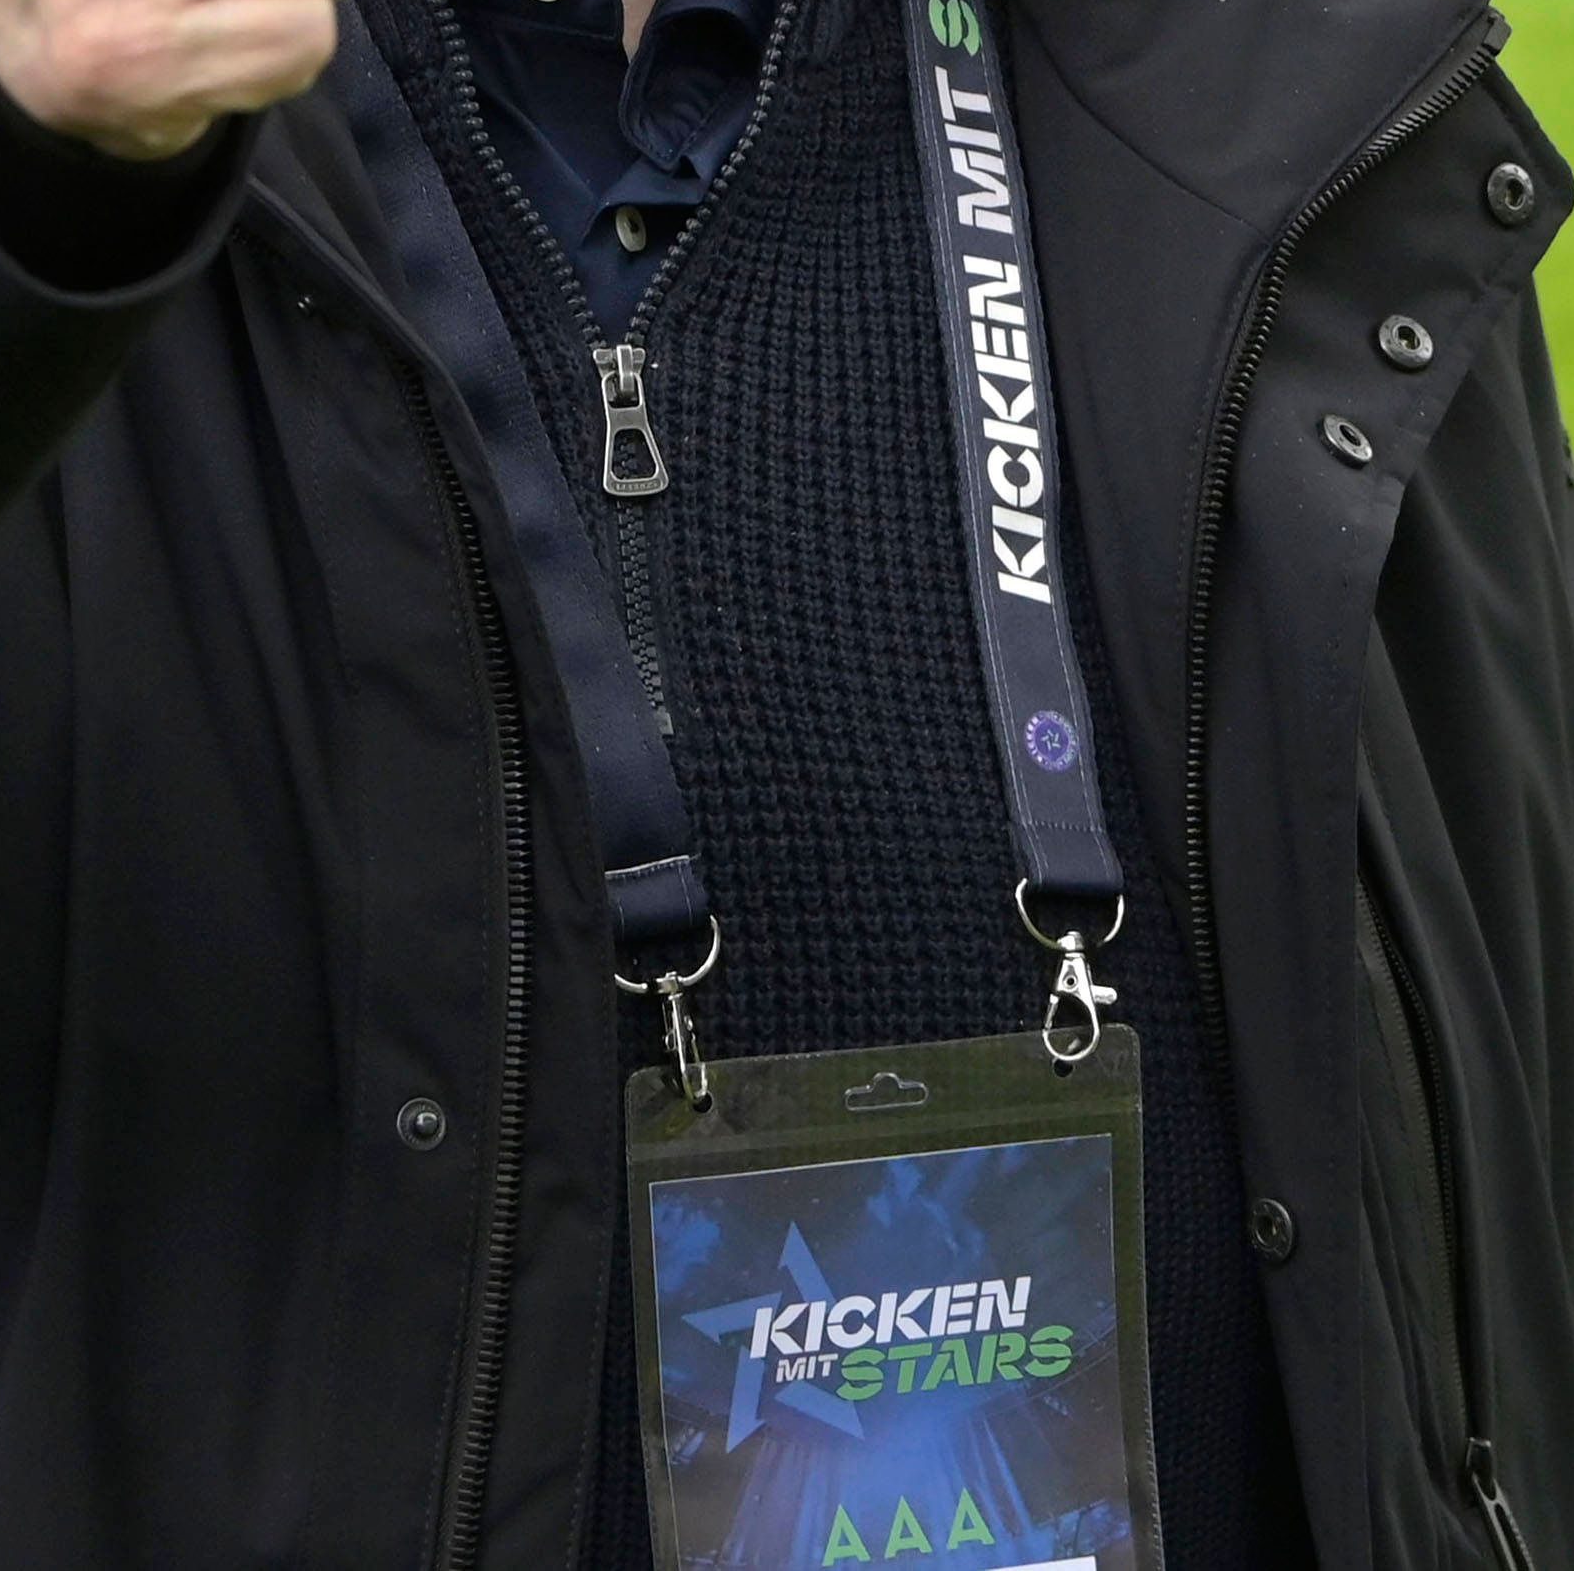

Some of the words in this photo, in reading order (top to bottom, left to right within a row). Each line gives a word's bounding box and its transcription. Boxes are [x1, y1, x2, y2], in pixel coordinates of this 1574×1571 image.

[935, 66, 1014, 233] MIT
[963, 255, 1051, 604] KICKEN
[750, 1276, 1031, 1358] KICKEN
[776, 1353, 838, 1383] MIT
[836, 1325, 1074, 1401] STARS
